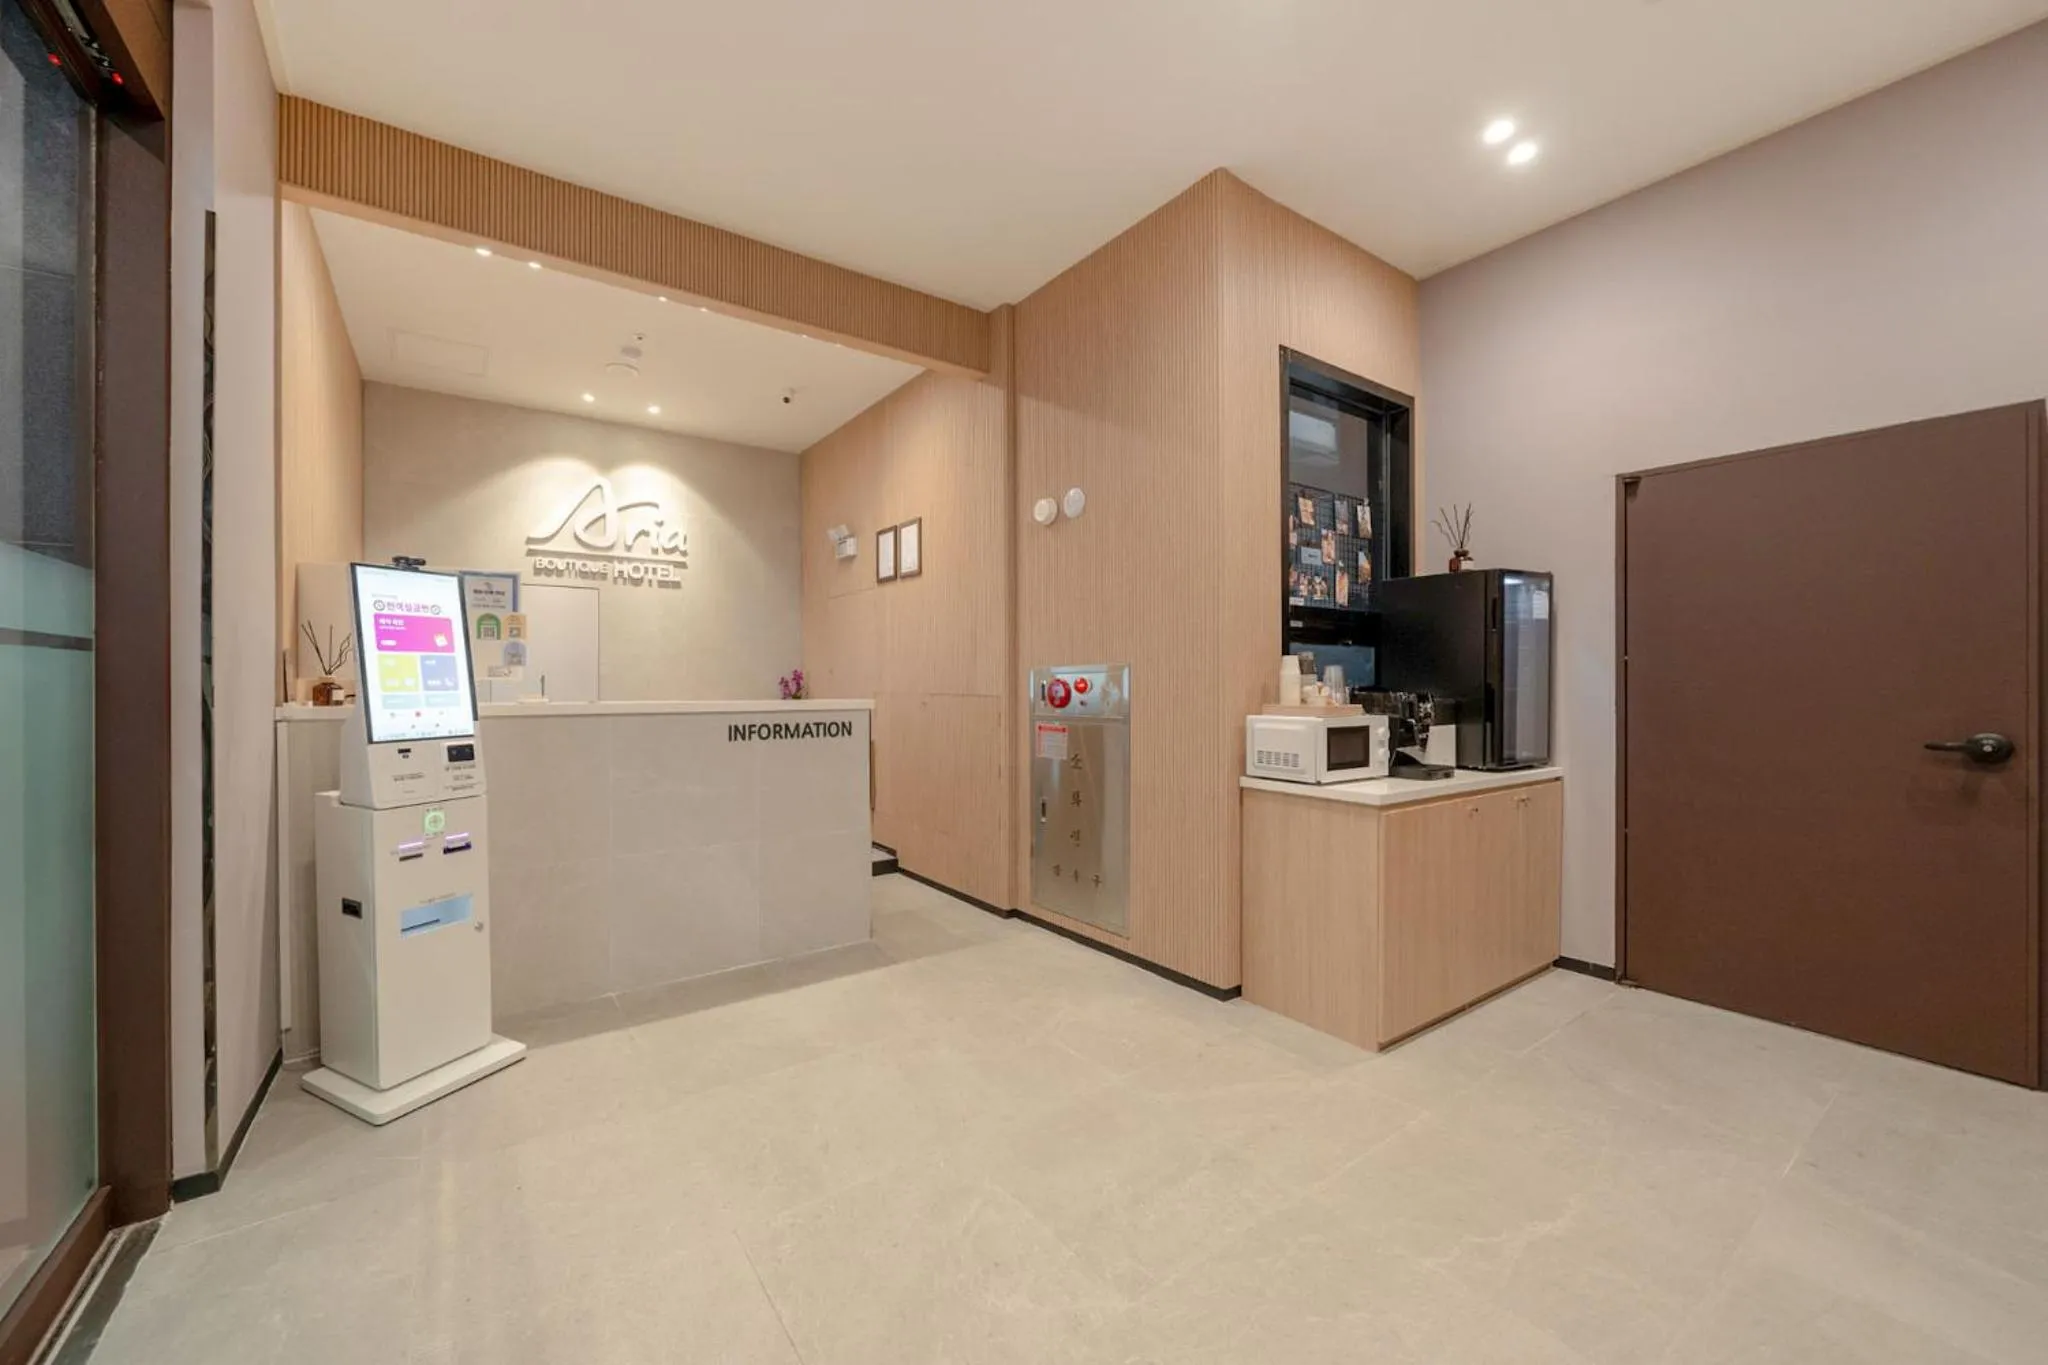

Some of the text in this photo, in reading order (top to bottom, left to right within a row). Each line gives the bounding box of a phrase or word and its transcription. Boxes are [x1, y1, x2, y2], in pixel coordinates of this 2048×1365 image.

[526, 476, 688, 556] Aria
[534, 556, 682, 587] BOUTIQUE HOTEL
[728, 721, 852, 742] INFORMATION
